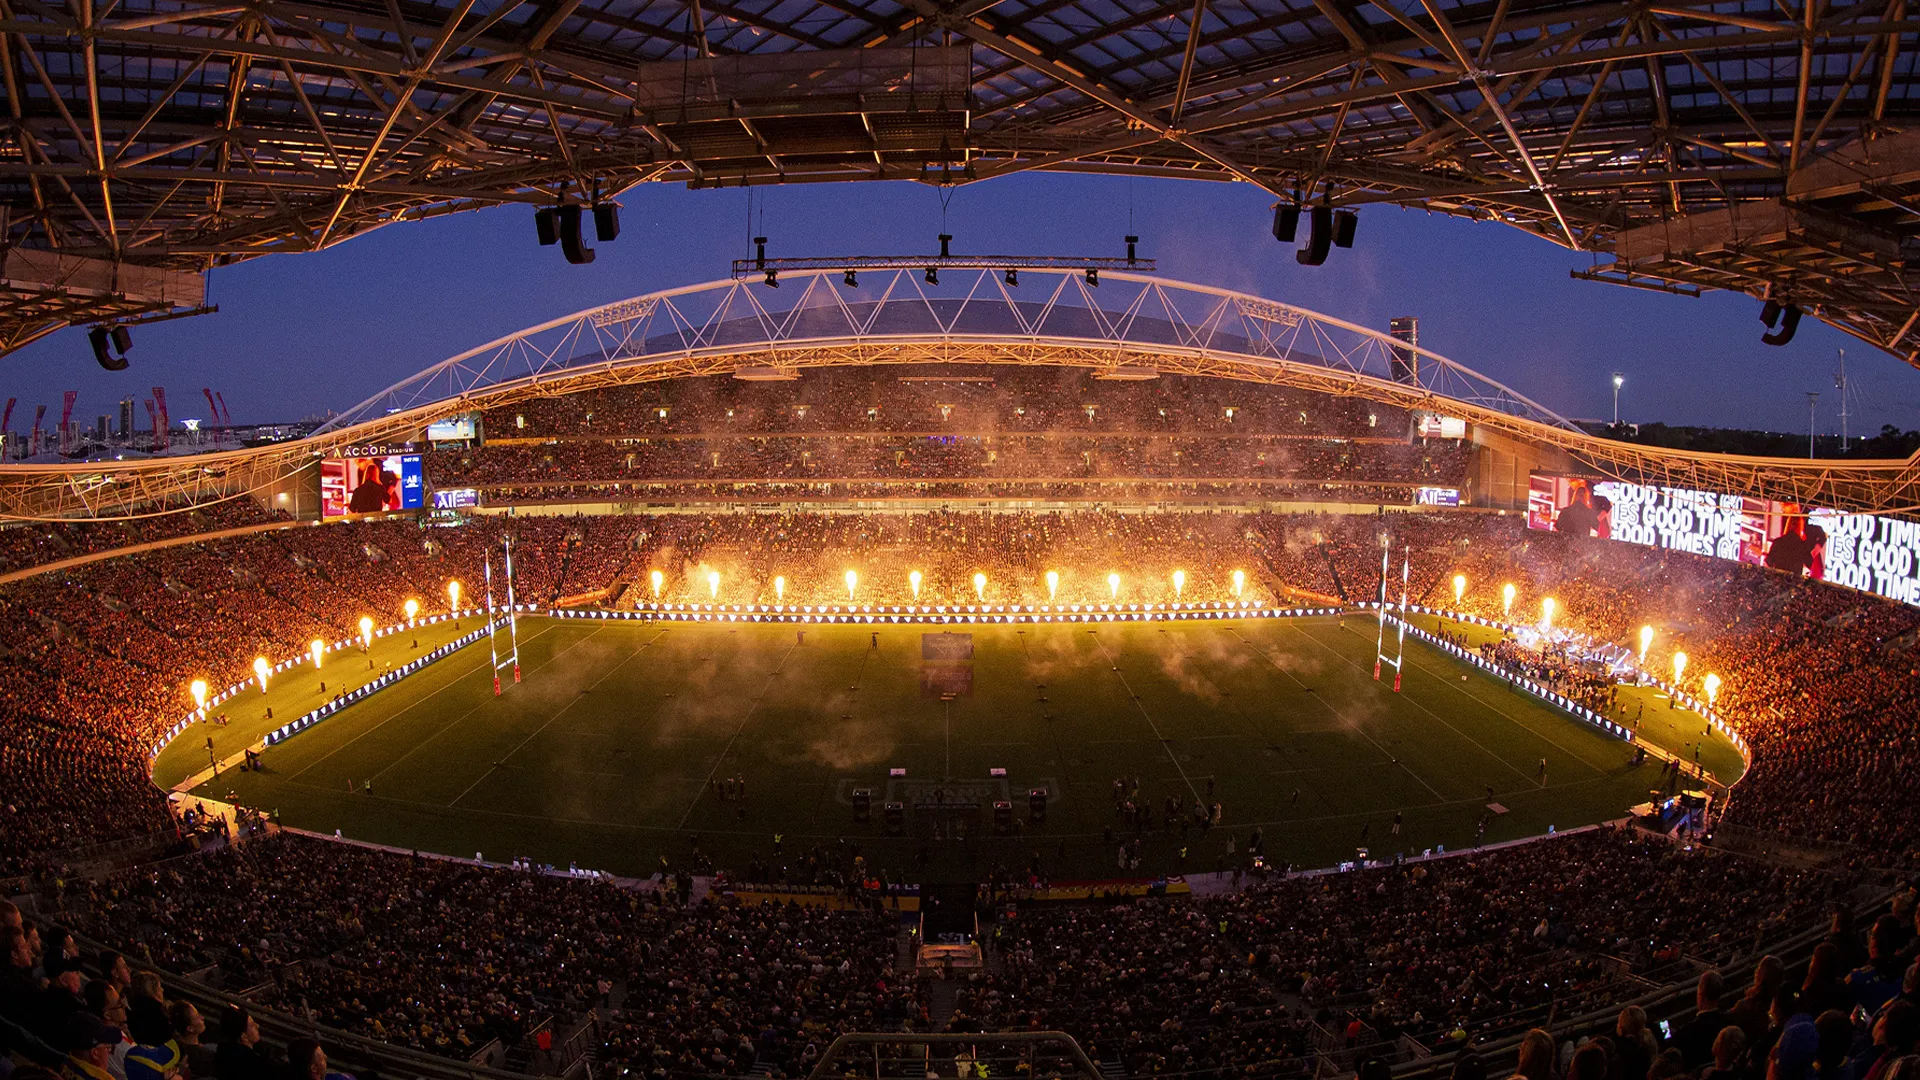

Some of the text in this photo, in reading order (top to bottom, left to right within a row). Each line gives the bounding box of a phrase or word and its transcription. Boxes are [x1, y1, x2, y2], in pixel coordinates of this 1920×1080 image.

[344, 446, 387, 457] ACCOR
[1661, 487, 1716, 514] TIMES
[1643, 505, 1693, 532] GOOD
[1697, 512, 1742, 539] TIME
[1659, 529, 1715, 556] TIMES
[1858, 539, 1912, 577] GOOD
[1874, 570, 1920, 607] TIME
